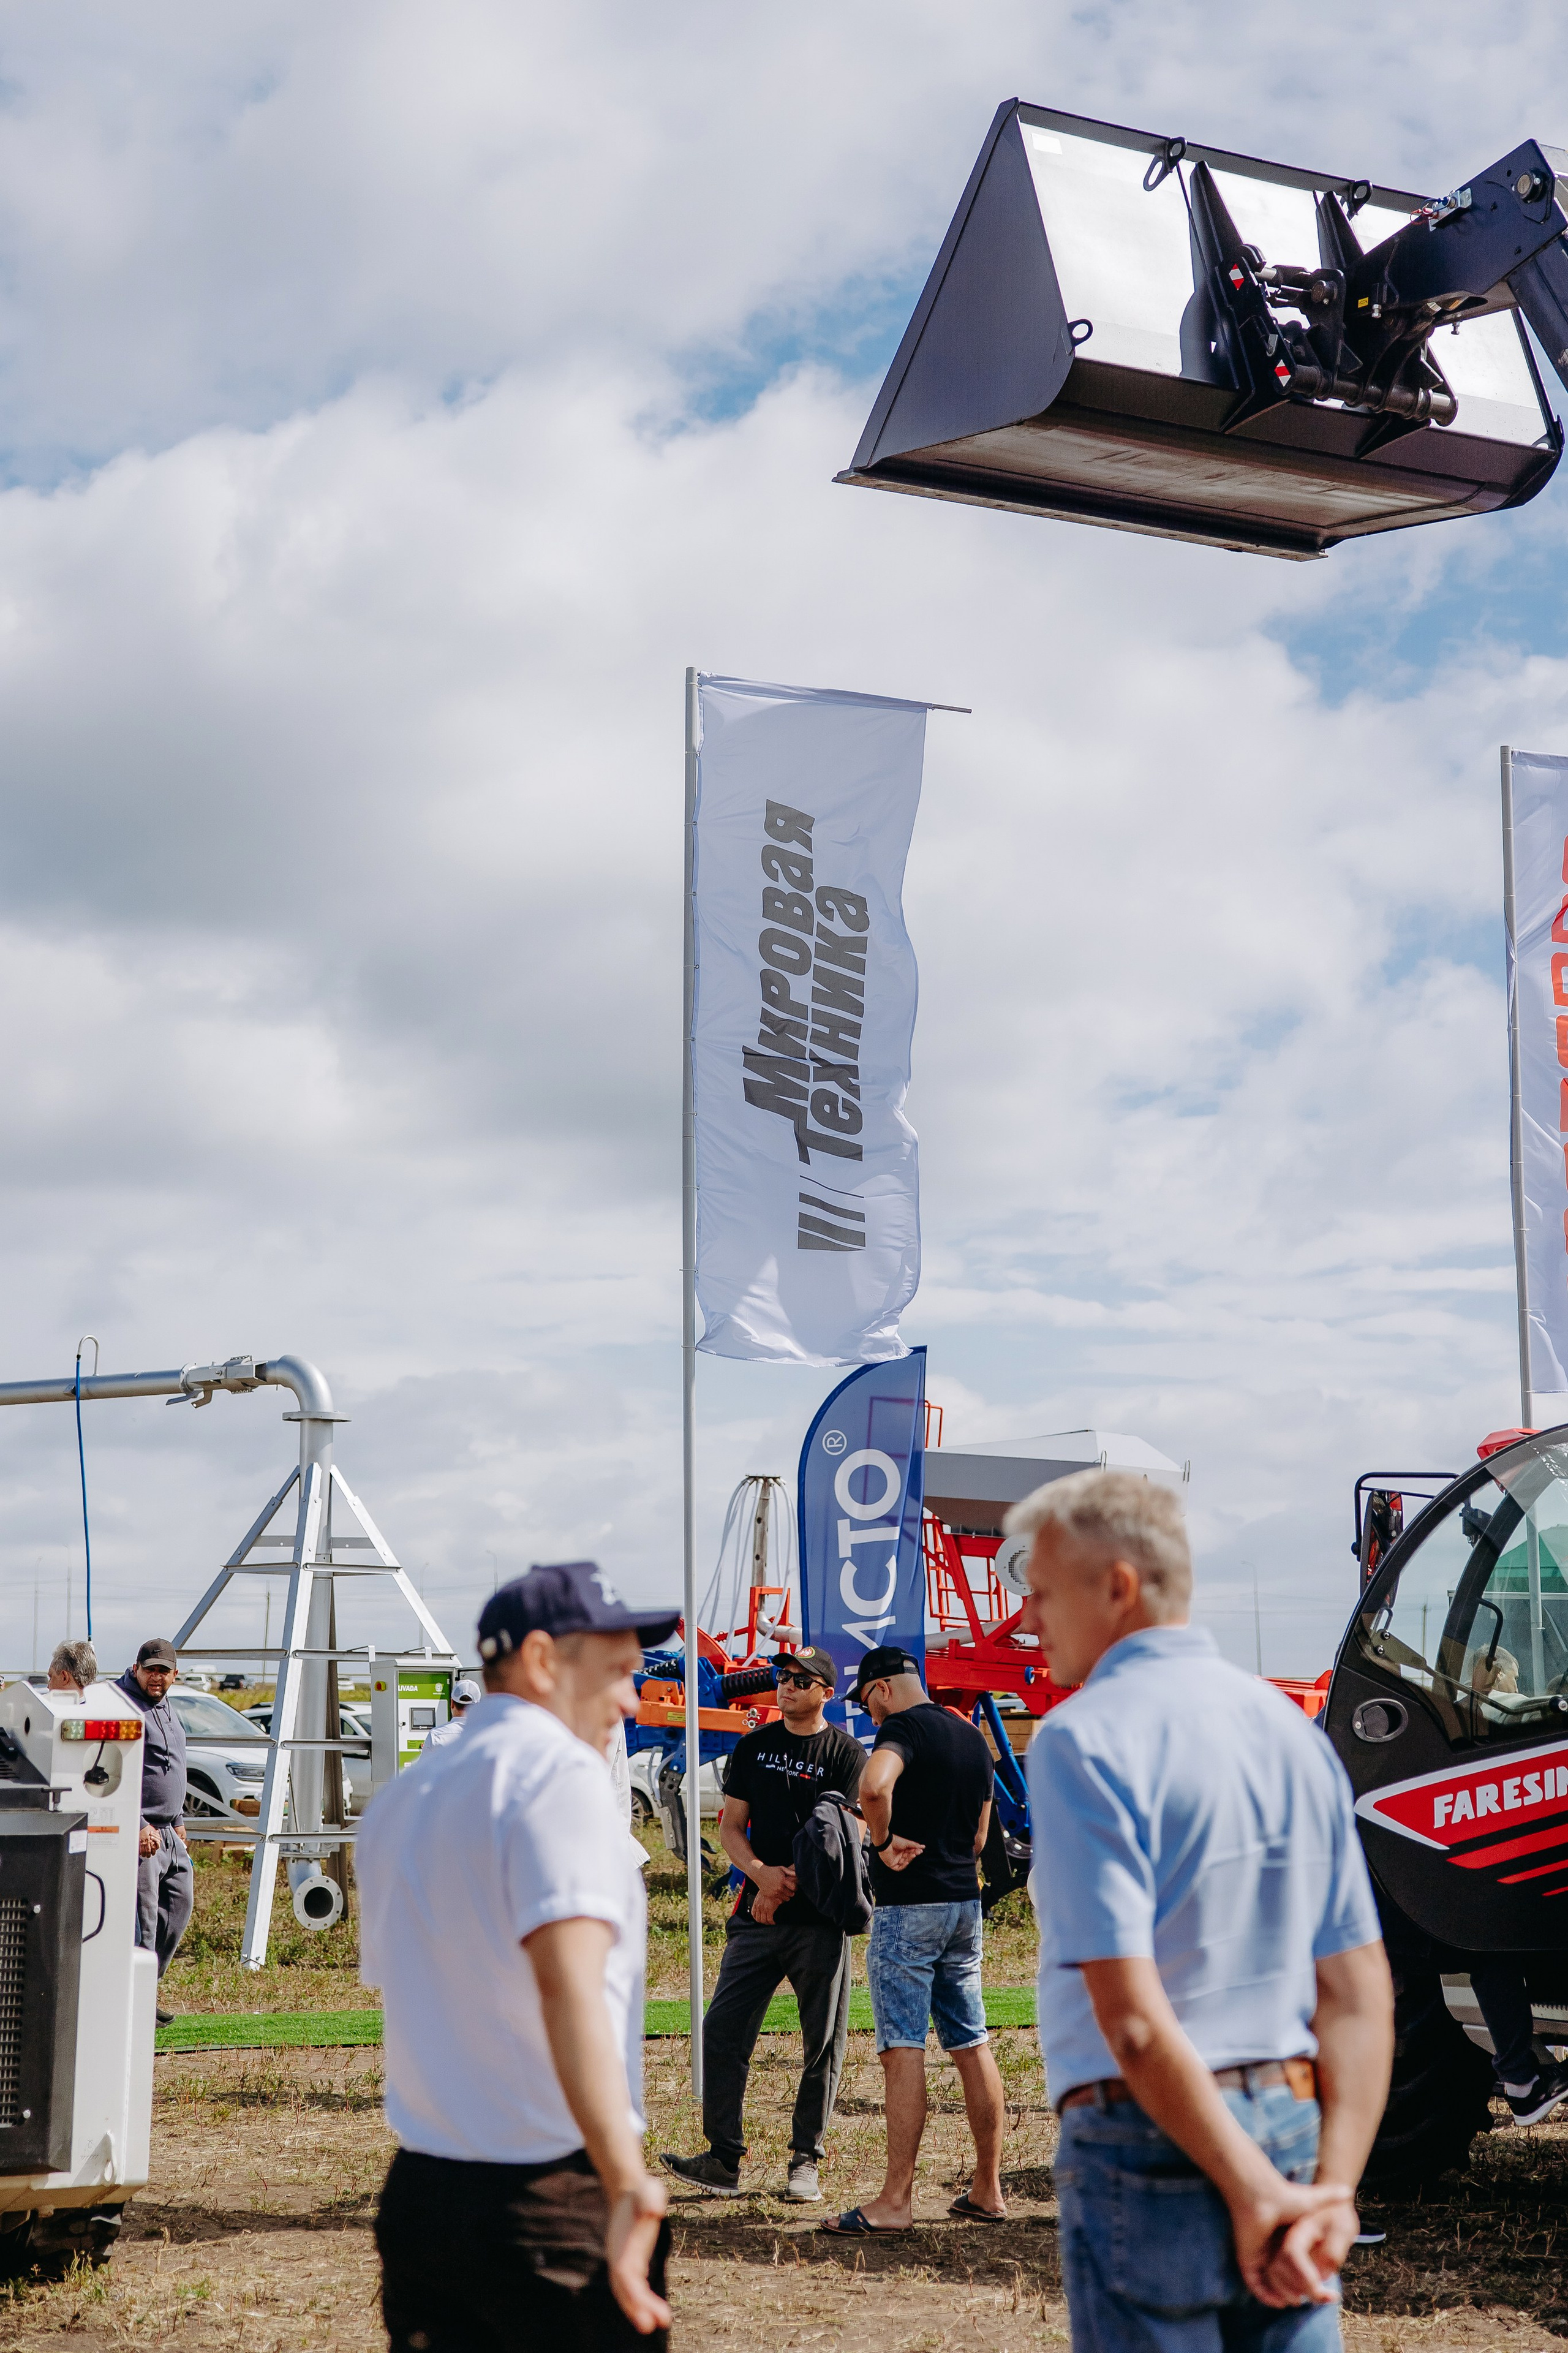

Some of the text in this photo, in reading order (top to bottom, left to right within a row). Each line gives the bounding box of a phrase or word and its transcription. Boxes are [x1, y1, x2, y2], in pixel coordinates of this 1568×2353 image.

[742, 799, 816, 1125] Мировая
[794, 886, 870, 1166] Техника
[757, 1752, 824, 1777] HILIGER
